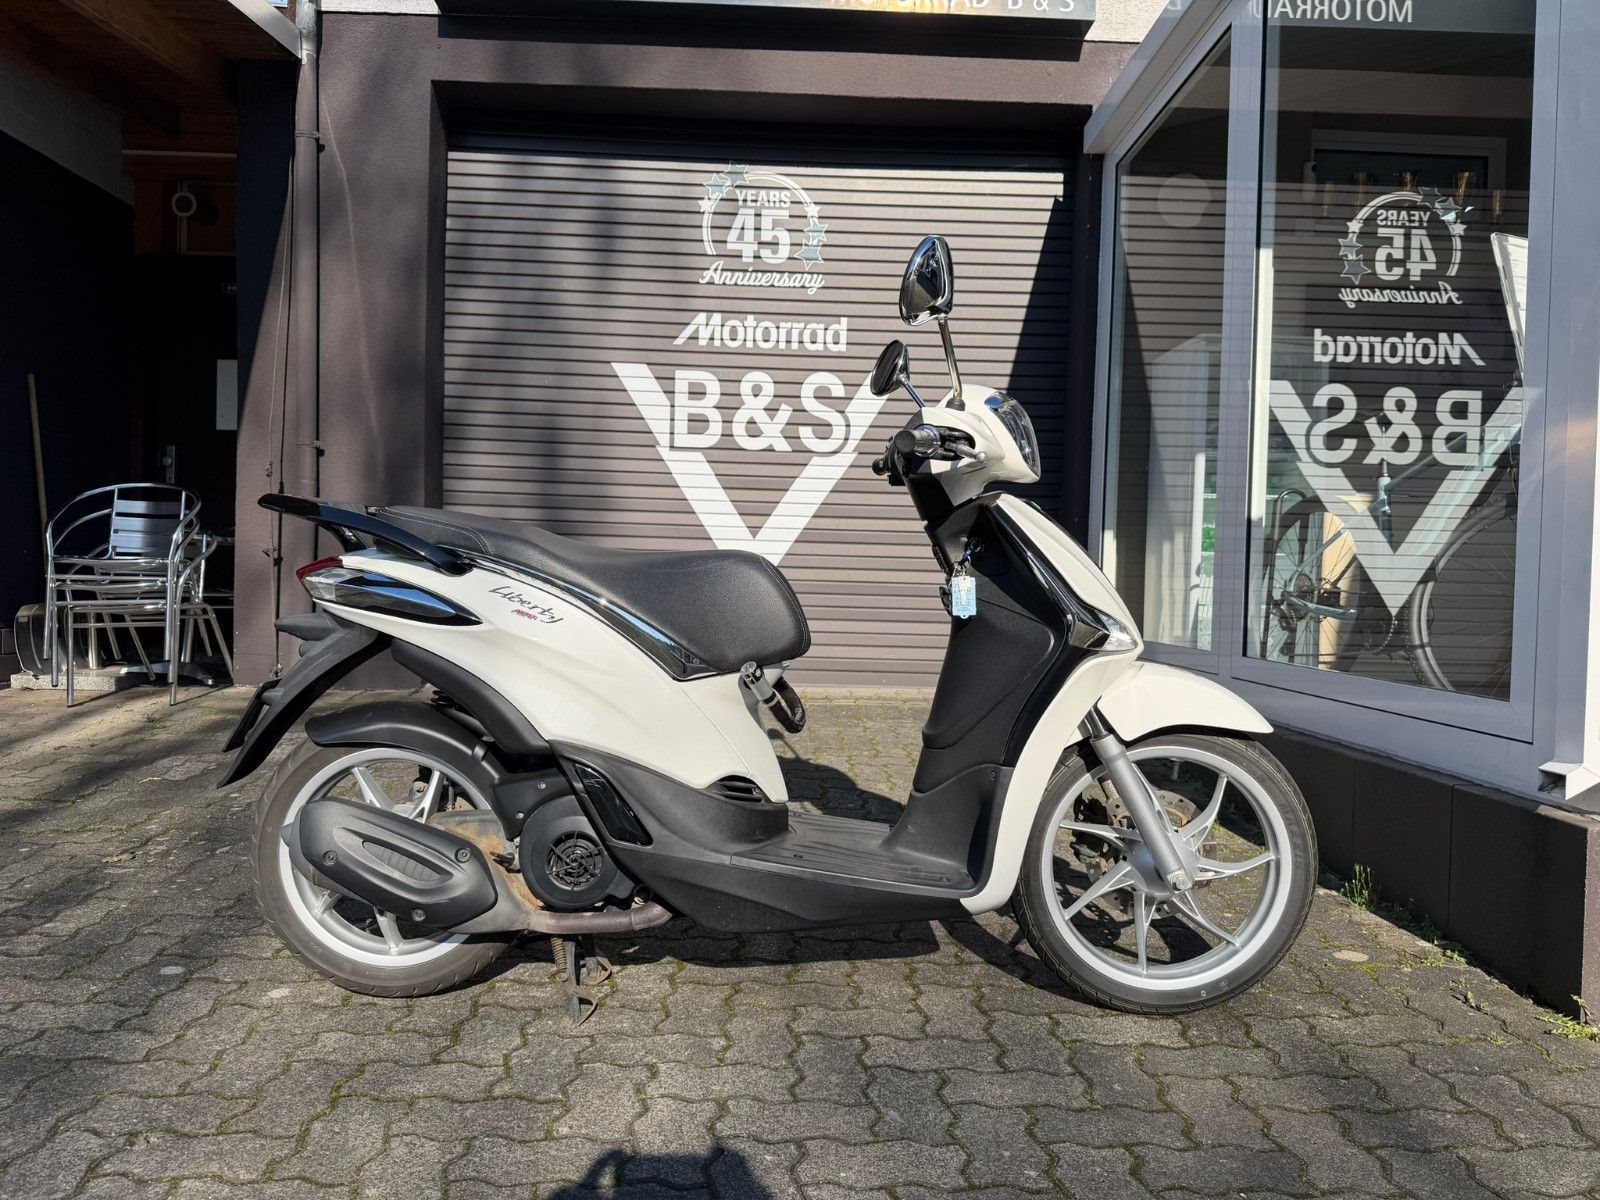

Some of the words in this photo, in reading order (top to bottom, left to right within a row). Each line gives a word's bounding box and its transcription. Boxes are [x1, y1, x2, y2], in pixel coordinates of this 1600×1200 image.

[735, 189, 791, 208] YEARS
[726, 208, 791, 265] 45
[699, 260, 825, 295] Anniversary
[672, 312, 848, 352] Motorrad
[488, 585, 564, 624] Liberty
